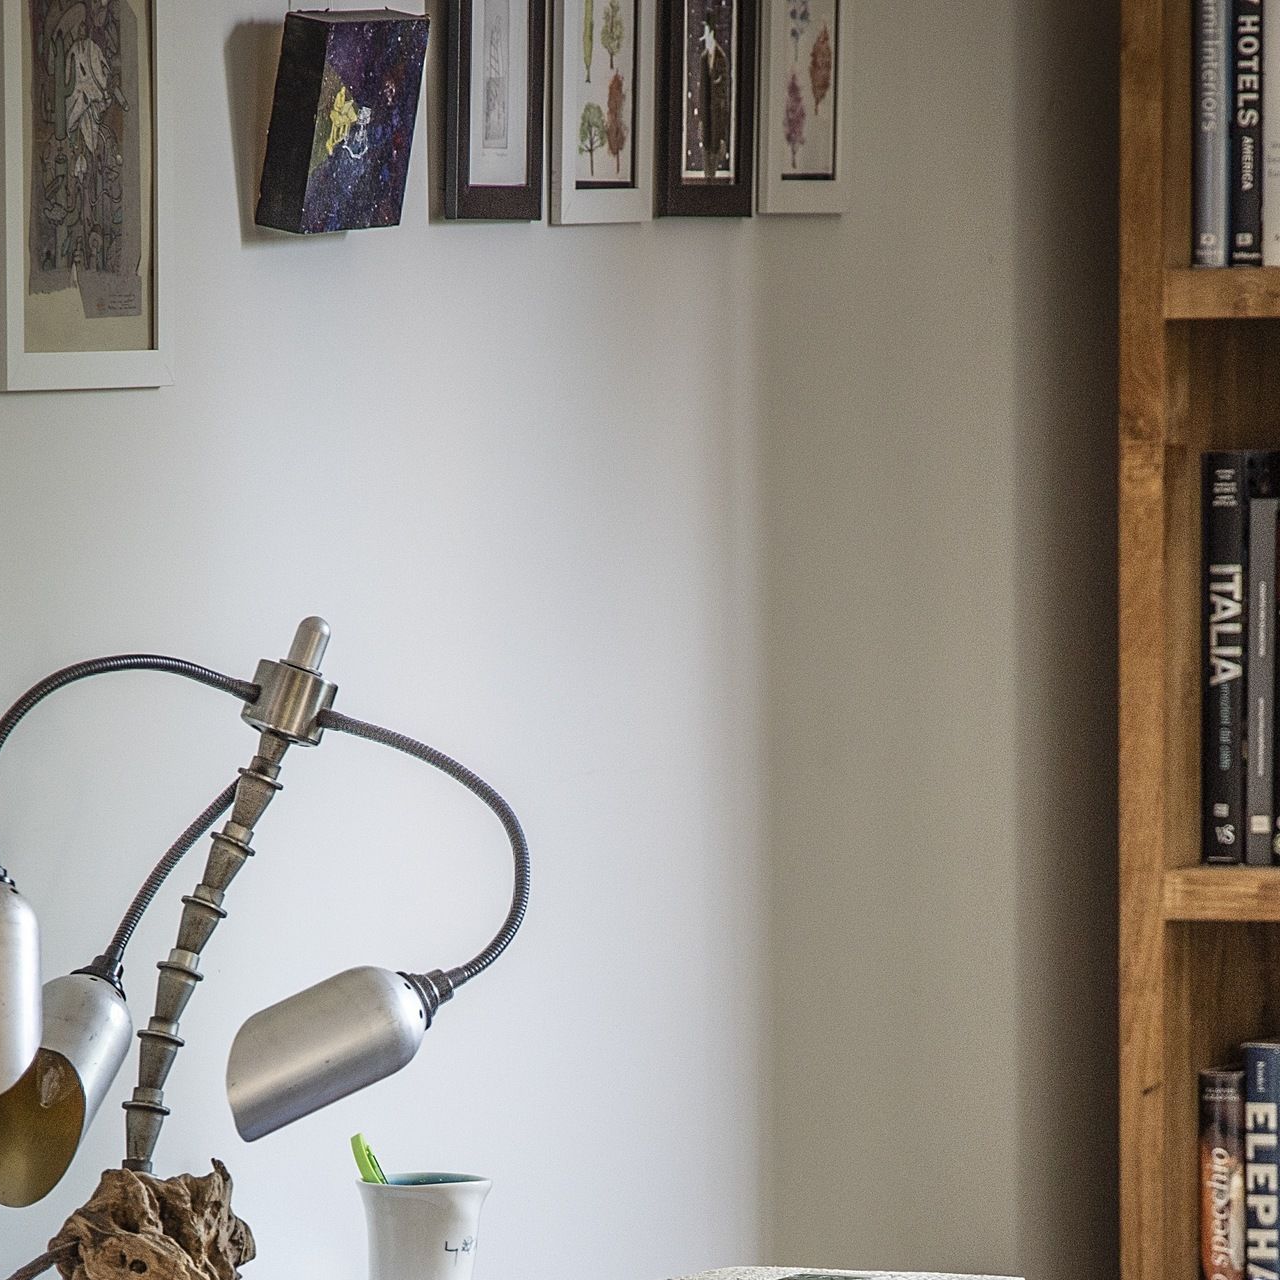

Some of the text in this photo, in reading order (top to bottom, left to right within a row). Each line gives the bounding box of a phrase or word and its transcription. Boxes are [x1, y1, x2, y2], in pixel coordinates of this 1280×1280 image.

[1237, 14, 1260, 191] HOTELS AMERICA
[1210, 564, 1243, 686] ITALIA
[1206, 1148, 1232, 1267] specchio
